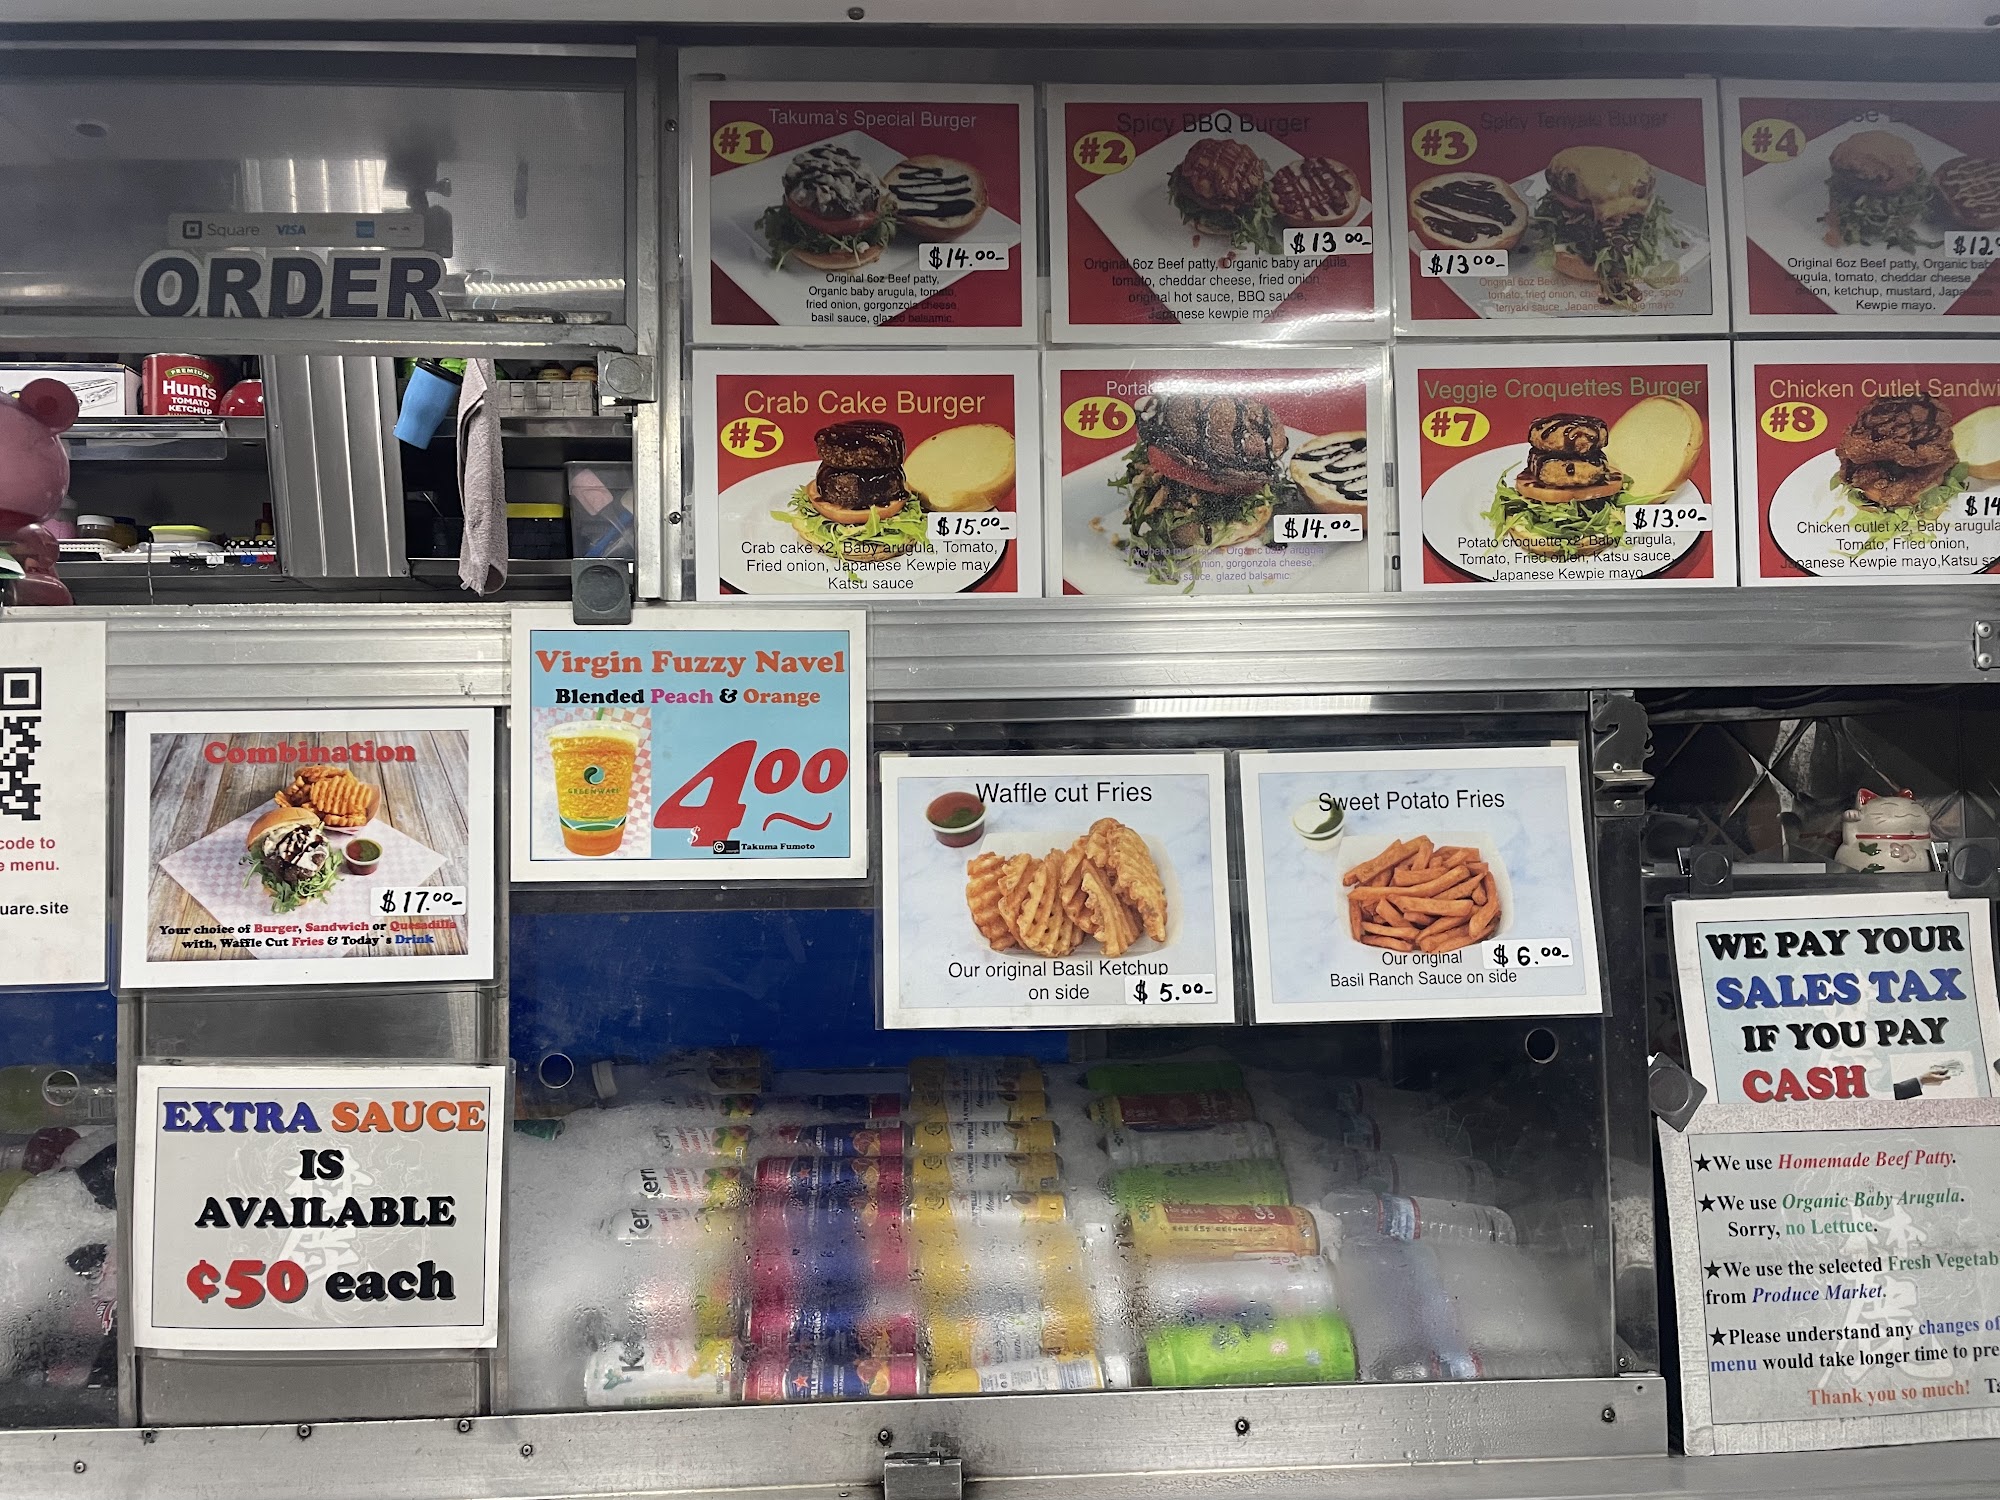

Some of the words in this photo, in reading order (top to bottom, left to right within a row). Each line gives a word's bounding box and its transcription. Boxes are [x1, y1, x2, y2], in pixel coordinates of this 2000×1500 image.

[769, 109, 848, 125] Takuma's
[853, 110, 914, 129] Special
[921, 111, 976, 130] Burger
[1117, 114, 1173, 136] Spicy
[1183, 114, 1232, 133] BBQ
[1240, 114, 1310, 136] Burger
[719, 127, 767, 154] #1
[1079, 137, 1127, 164] #2
[1421, 130, 1469, 159] #3
[1752, 127, 1798, 156] #4
[208, 224, 259, 237] Square
[276, 225, 305, 235] VISA
[1787, 258, 1832, 270] Original
[1836, 259, 1856, 268] 6oz
[1861, 258, 1886, 268] Beef
[1889, 259, 1920, 271] patty,
[1923, 259, 1967, 272] Organic
[140, 257, 443, 317] ORDER
[826, 274, 864, 285] Original
[867, 274, 884, 282] 6oz
[888, 274, 910, 282] Beef
[914, 274, 939, 285] patty,
[1857, 300, 1898, 313] Kewpie
[1902, 301, 1935, 313] mayo.
[171, 368, 210, 379] PREMIUM
[1424, 380, 1497, 403] Veggie
[1505, 378, 1622, 402] Croquettes
[1631, 377, 1701, 399] Burger
[1770, 380, 1853, 398] Chicken
[1861, 379, 1922, 397] Cutlet
[169, 405, 212, 415] KETCHUP
[171, 397, 209, 407] TOMATO
[744, 390, 809, 414] Crab
[818, 390, 887, 414] Cake
[897, 391, 985, 419] Burger
[1078, 403, 1127, 430] #6
[1430, 412, 1476, 442] #7
[1770, 407, 1815, 432] #8
[729, 422, 777, 452] #5
[741, 542, 775, 555] Crab
[780, 542, 812, 554] cake
[817, 542, 838, 555] x2,
[843, 542, 877, 557] Baby
[882, 542, 938, 557] arugula,
[943, 541, 997, 555] Tomato,
[1458, 537, 1499, 549] Potato
[1503, 535, 1561, 550] croquette
[1589, 535, 1621, 548] Baby
[1626, 534, 1676, 548] arugula,
[1836, 538, 1888, 551] Tomato,
[1893, 538, 1926, 549] Fried
[1929, 537, 1969, 550] onion,
[1226, 559, 1277, 569] gorgonzola
[828, 577, 867, 589] Katsu
[872, 579, 914, 589] sauce
[535, 650, 642, 679] Virgin
[652, 650, 746, 678] Fuzzy
[756, 650, 844, 673] Navel
[556, 689, 645, 704] Blended
[651, 689, 713, 704] Peach
[720, 689, 738, 704] &
[743, 688, 820, 707] Orange
[204, 741, 416, 764] Combination
[976, 783, 1047, 803] Waffle
[1054, 785, 1088, 802] cut
[1097, 782, 1152, 801] Fries
[1319, 793, 1379, 811] Sweet
[1387, 791, 1450, 810] Potato
[1457, 790, 1505, 808] Fries
[40, 836, 55, 849] to
[11, 859, 59, 871] menu.
[159, 925, 191, 935] Your
[194, 923, 234, 934] choice
[239, 923, 250, 934] of
[254, 923, 302, 935] Burger,
[305, 921, 369, 932] Sandwich
[372, 923, 386, 931] or
[390, 920, 456, 931] Quesadilla
[182, 939, 216, 951] with,
[220, 938, 261, 948] Waffle
[266, 938, 288, 947] Cut
[292, 937, 323, 947] Fries
[327, 937, 337, 946] &
[395, 934, 434, 945] Drink
[1705, 932, 1768, 960] WE
[1775, 929, 1850, 957] PAY
[1857, 925, 1965, 955] YOUR
[1382, 952, 1408, 965] Our
[1412, 951, 1462, 968] original
[949, 962, 980, 978] Our
[986, 961, 1046, 981] original
[1053, 961, 1093, 976] Basil
[1099, 960, 1168, 976] Ketchup
[1330, 974, 1364, 987] Basil
[1369, 972, 1413, 986] Ranch
[1419, 972, 1462, 985] Sauce
[1467, 974, 1484, 983] on
[1489, 970, 1517, 983] side
[1028, 988, 1050, 999] on
[1055, 984, 1090, 999] side
[1716, 972, 1861, 1010] SALES
[1869, 968, 1967, 1004] TAX
[1741, 1024, 1780, 1051] IF
[1786, 1020, 1867, 1050] YOU
[1875, 1017, 1949, 1046] PAY
[1742, 1065, 1870, 1103] CASH
[162, 1102, 322, 1133] EXTRA
[331, 1100, 485, 1132] SAUCE
[299, 1149, 344, 1181] IS
[1713, 1156, 1741, 1171] We
[1746, 1159, 1773, 1170] use
[1778, 1154, 1870, 1169] Homemade
[1875, 1152, 1911, 1169] Beef
[1914, 1150, 1956, 1167] Patty.
[1717, 1196, 1744, 1211] We
[1750, 1198, 1777, 1210] use
[1782, 1193, 1848, 1213] Organic
[1854, 1191, 1892, 1209] Baby
[1897, 1188, 1964, 1206] Arugula.
[194, 1196, 456, 1229] AVAILABLE
[1728, 1222, 1780, 1239] Sorry,
[1786, 1223, 1805, 1235] no
[1812, 1219, 1877, 1234] Lettuce.
[187, 1259, 308, 1309] ¢50
[325, 1261, 456, 1303] each
[1808, 1388, 1862, 1405] Thank
[1868, 1388, 1896, 1406] you
[1901, 1388, 1916, 1398] so
[1922, 1379, 1970, 1397] much!
